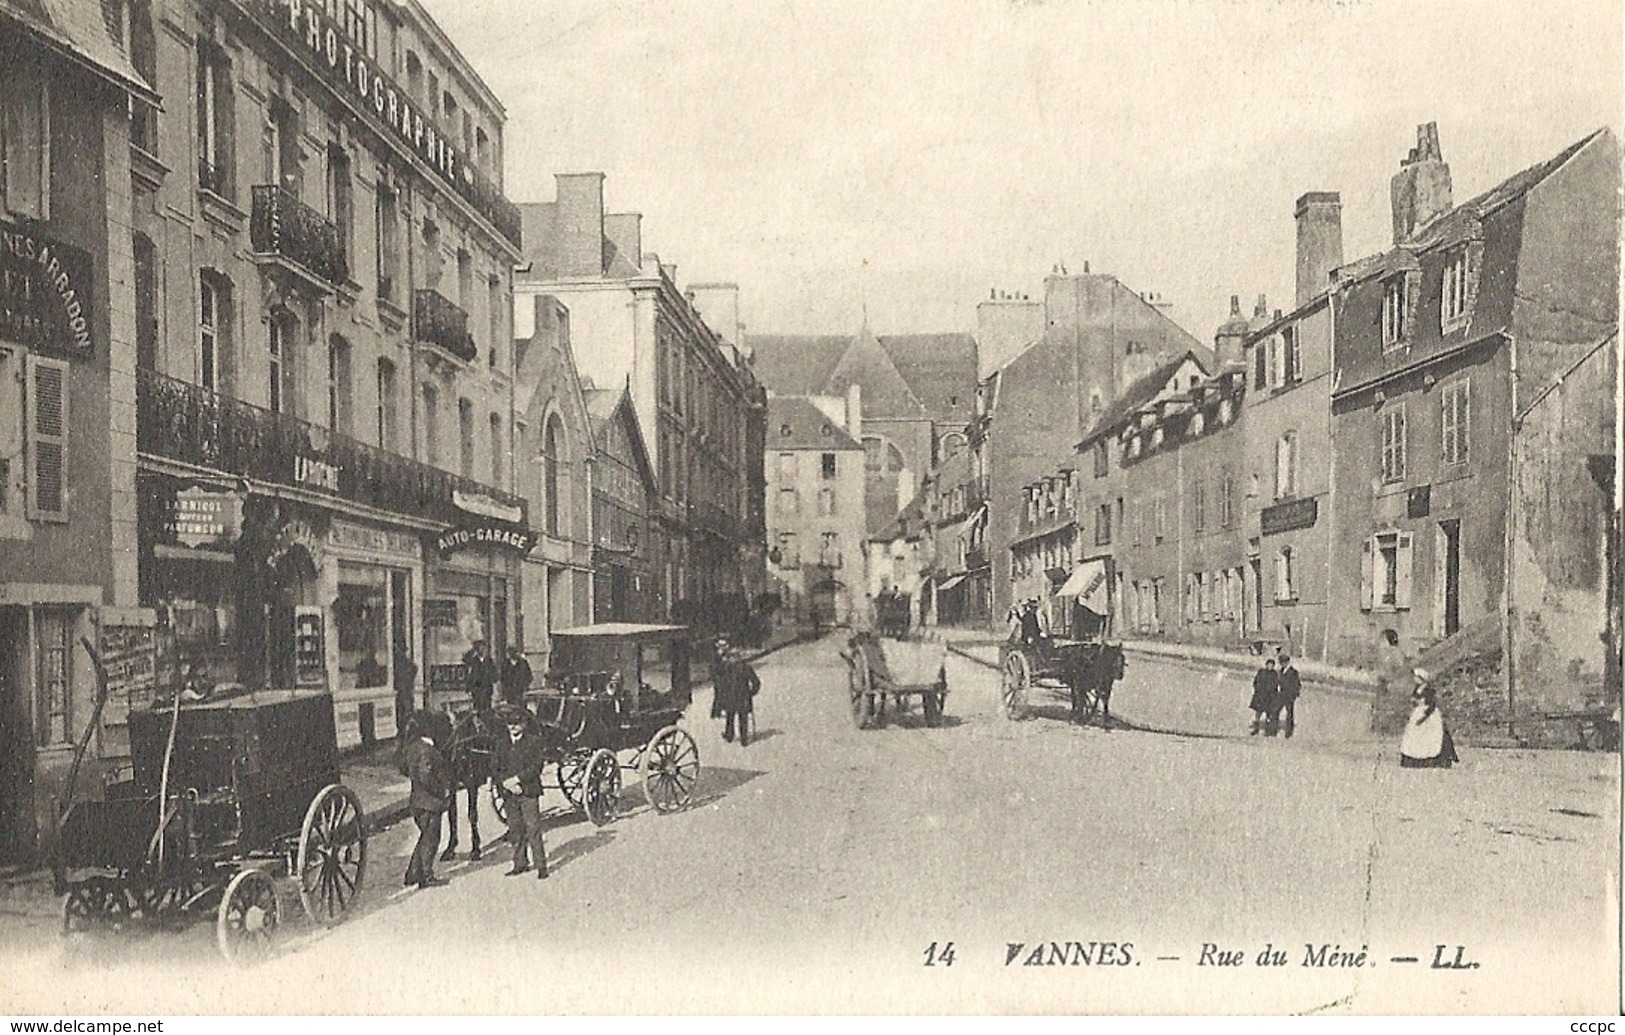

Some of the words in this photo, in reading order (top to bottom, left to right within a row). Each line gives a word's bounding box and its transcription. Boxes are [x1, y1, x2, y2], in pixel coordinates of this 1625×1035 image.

[289, 0, 456, 180] PHOTOGRAPHIE
[38, 246, 92, 348] ARRADON
[438, 527, 529, 551] AUTO-GARAGE
